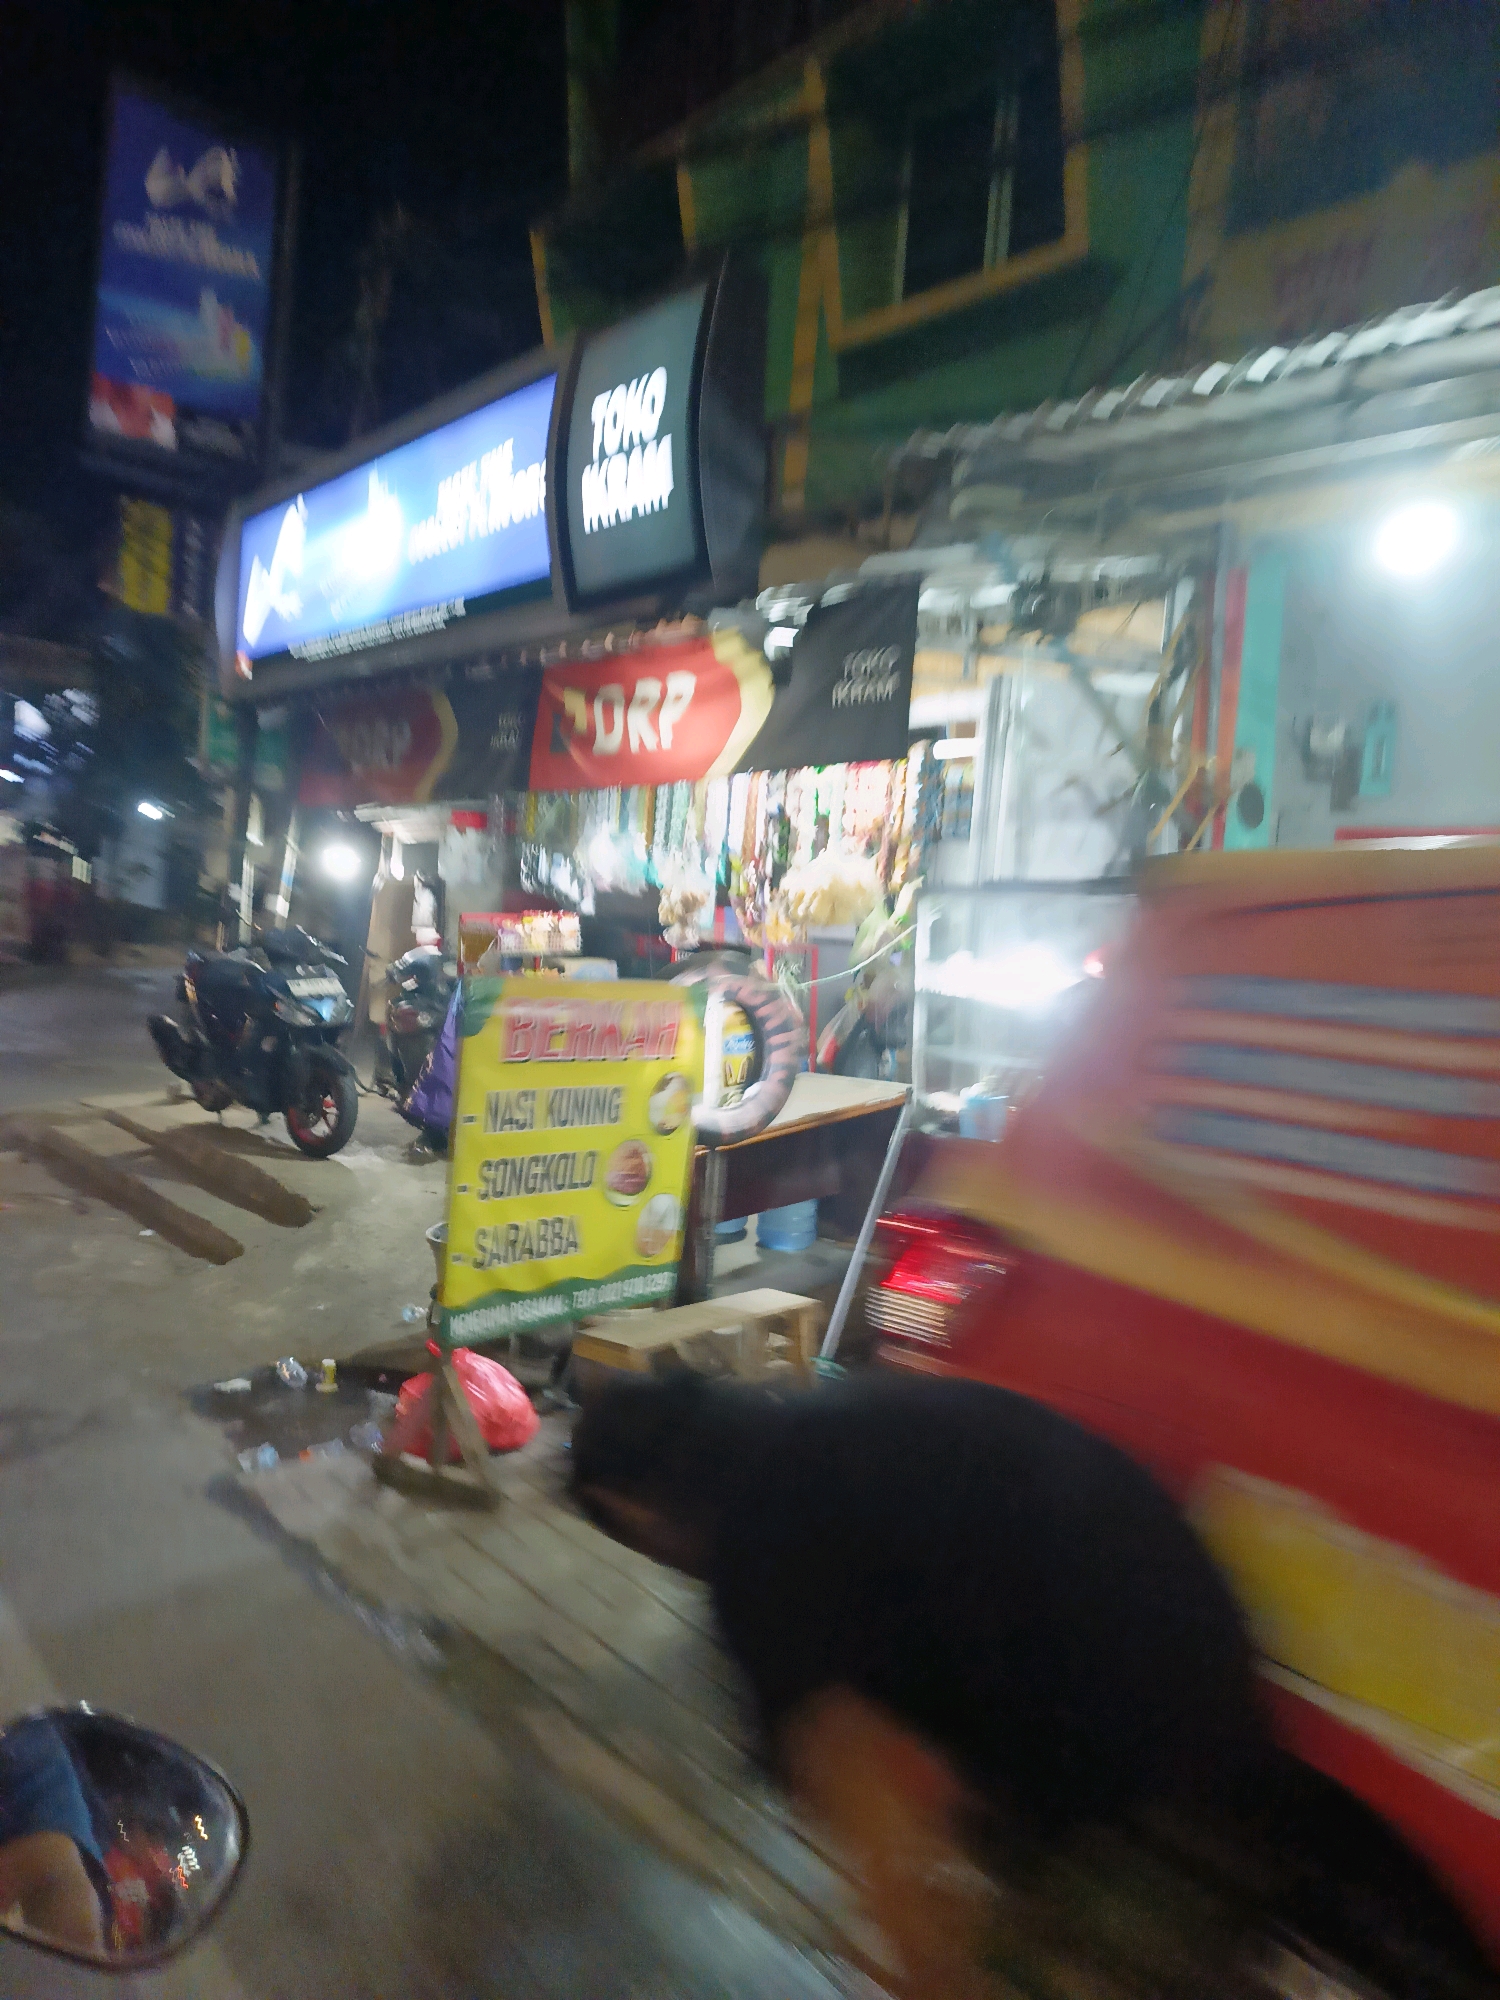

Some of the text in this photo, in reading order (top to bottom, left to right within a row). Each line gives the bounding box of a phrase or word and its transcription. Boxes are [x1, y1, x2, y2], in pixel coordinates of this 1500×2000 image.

[591, 366, 667, 462] TOKO
[582, 433, 674, 535] IKRAM
[843, 644, 901, 681] TOKO
[502, 998, 682, 1063] BERKAH
[485, 1085, 623, 1133] NASI KUNING
[477, 1151, 600, 1201] SONGKOLO
[472, 1215, 581, 1270] SARABBA
